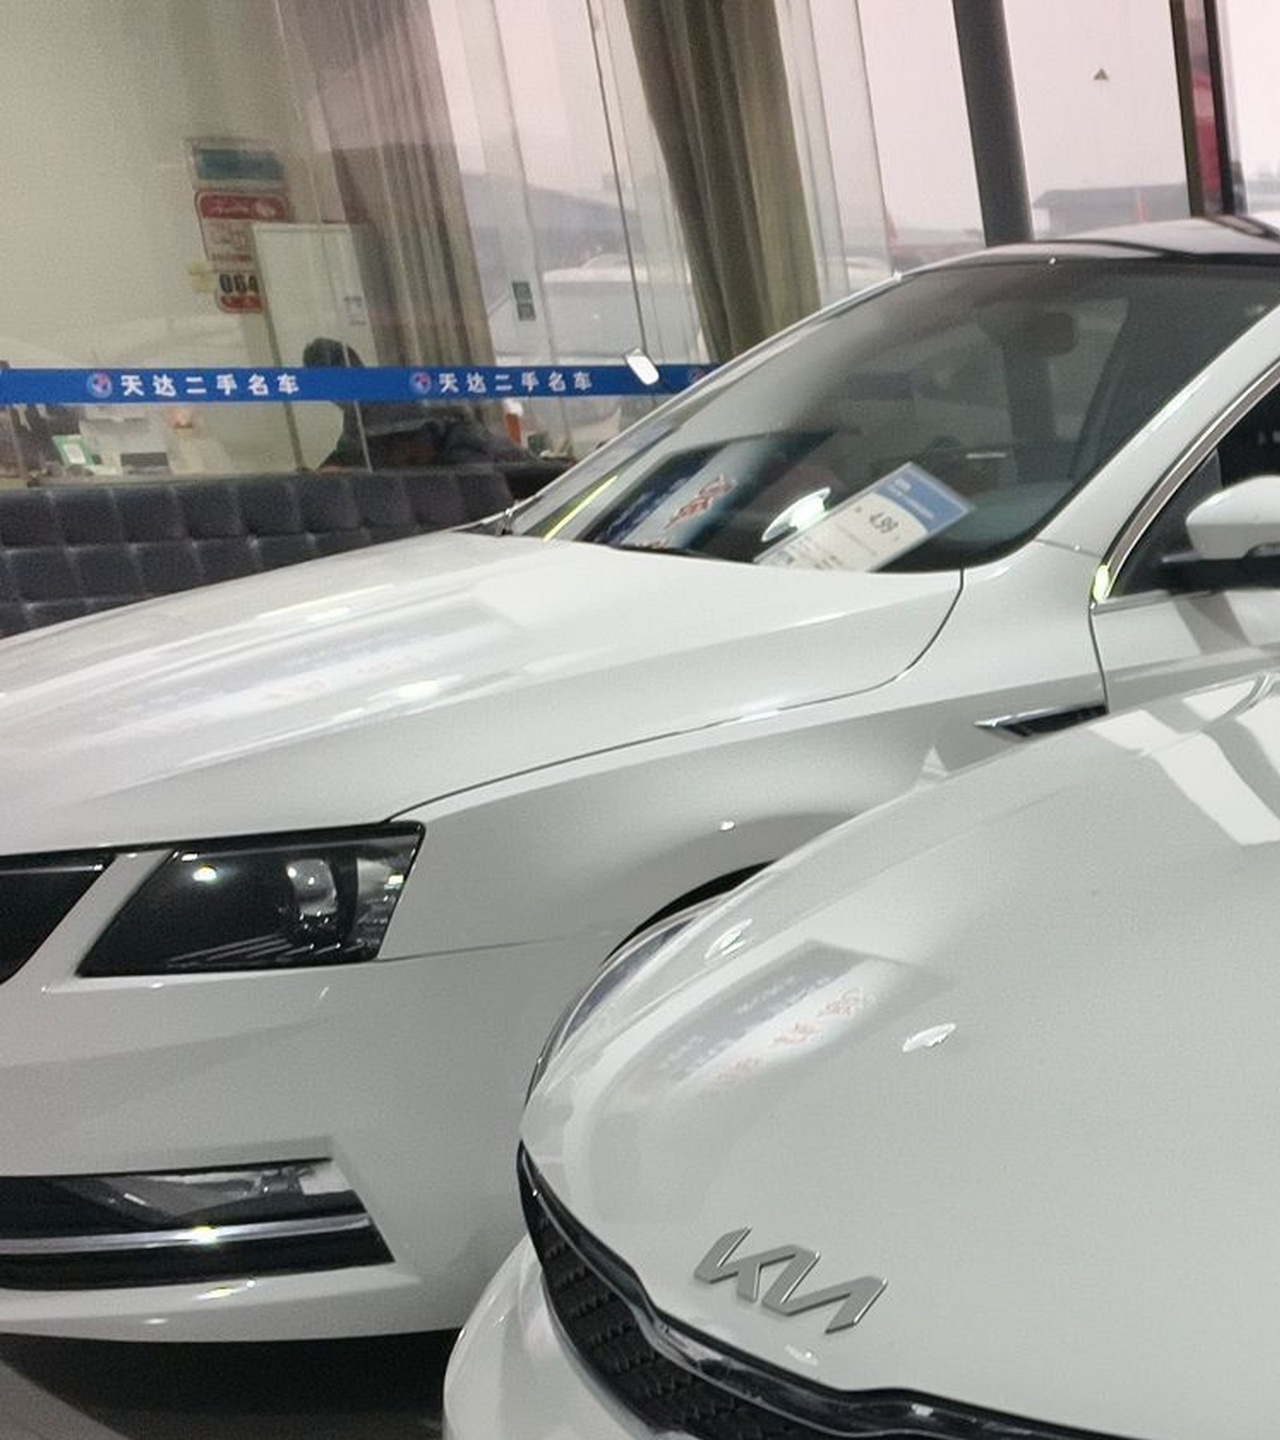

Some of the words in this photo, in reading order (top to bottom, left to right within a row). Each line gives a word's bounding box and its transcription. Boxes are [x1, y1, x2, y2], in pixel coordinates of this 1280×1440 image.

[120, 372, 300, 397] 天达二手名车
[438, 370, 594, 394] 天达二手名车
[693, 1226, 888, 1334] KIA
